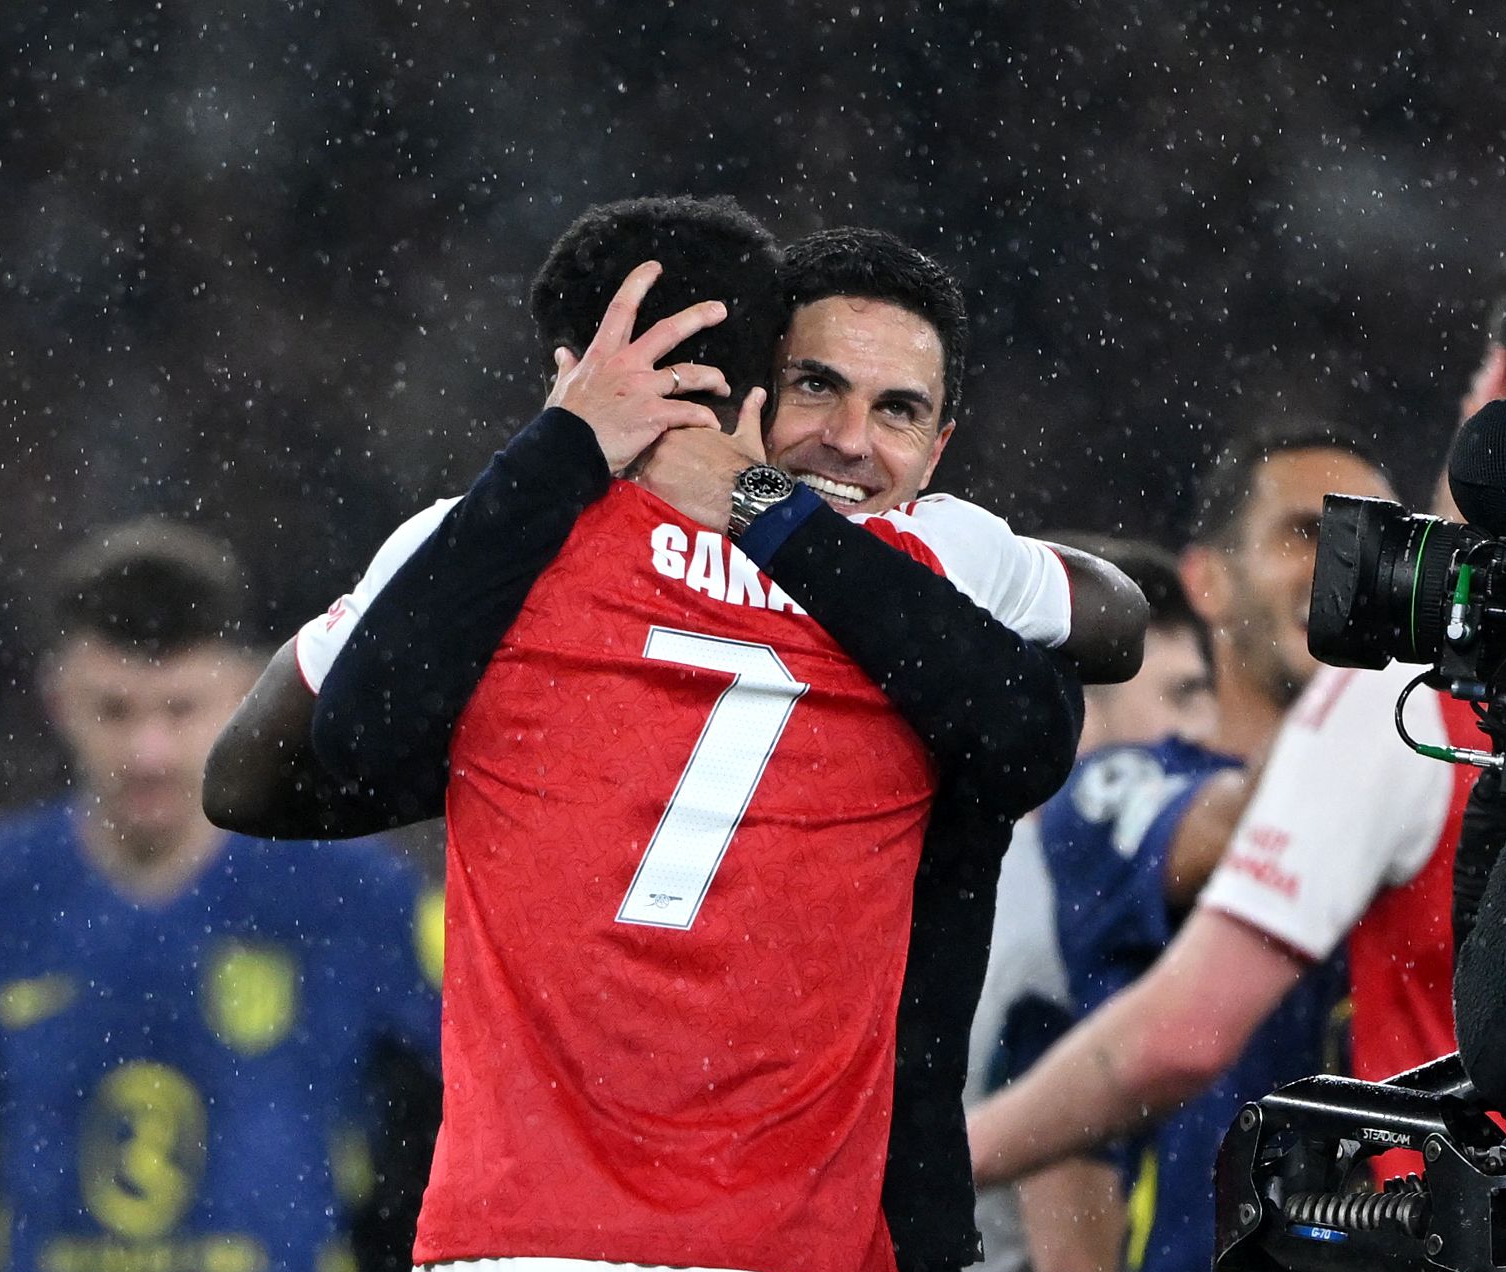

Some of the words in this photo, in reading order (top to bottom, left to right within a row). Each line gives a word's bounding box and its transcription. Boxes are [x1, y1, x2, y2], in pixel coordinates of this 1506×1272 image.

[614, 625, 810, 930] 7
[1362, 1129, 1411, 1146] STEADICAM
[1311, 1227, 1331, 1239] G-70
